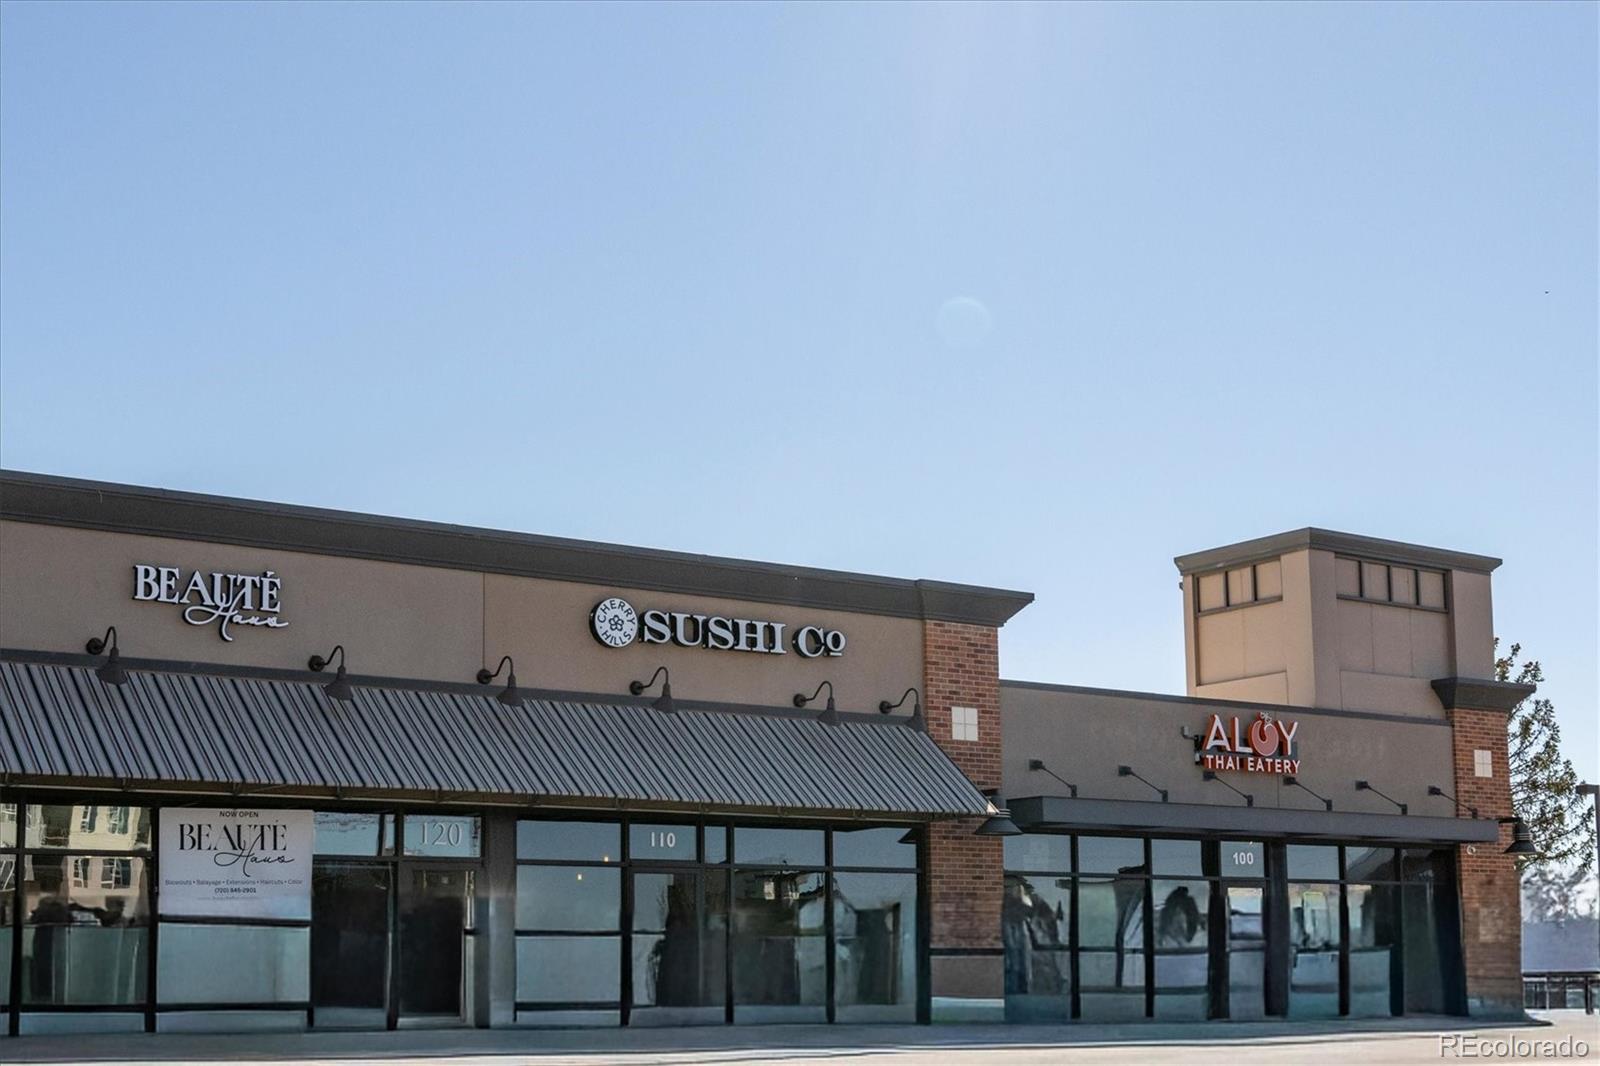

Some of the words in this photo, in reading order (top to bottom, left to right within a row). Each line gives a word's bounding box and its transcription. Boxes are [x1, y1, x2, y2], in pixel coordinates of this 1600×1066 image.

[134, 564, 281, 612] BEAUTÉ
[184, 589, 289, 642] Haus
[597, 599, 636, 625] CHERRY
[601, 629, 632, 646] HILLS
[642, 610, 787, 655] SUSHI
[796, 626, 847, 658] Co
[1204, 712, 1298, 757] ALOY
[1206, 755, 1240, 770] THAI
[1247, 758, 1301, 774] EATERY
[422, 822, 462, 847] 120
[651, 831, 676, 848] 110
[213, 833, 295, 878] Haus
[1232, 851, 1254, 865] 100
